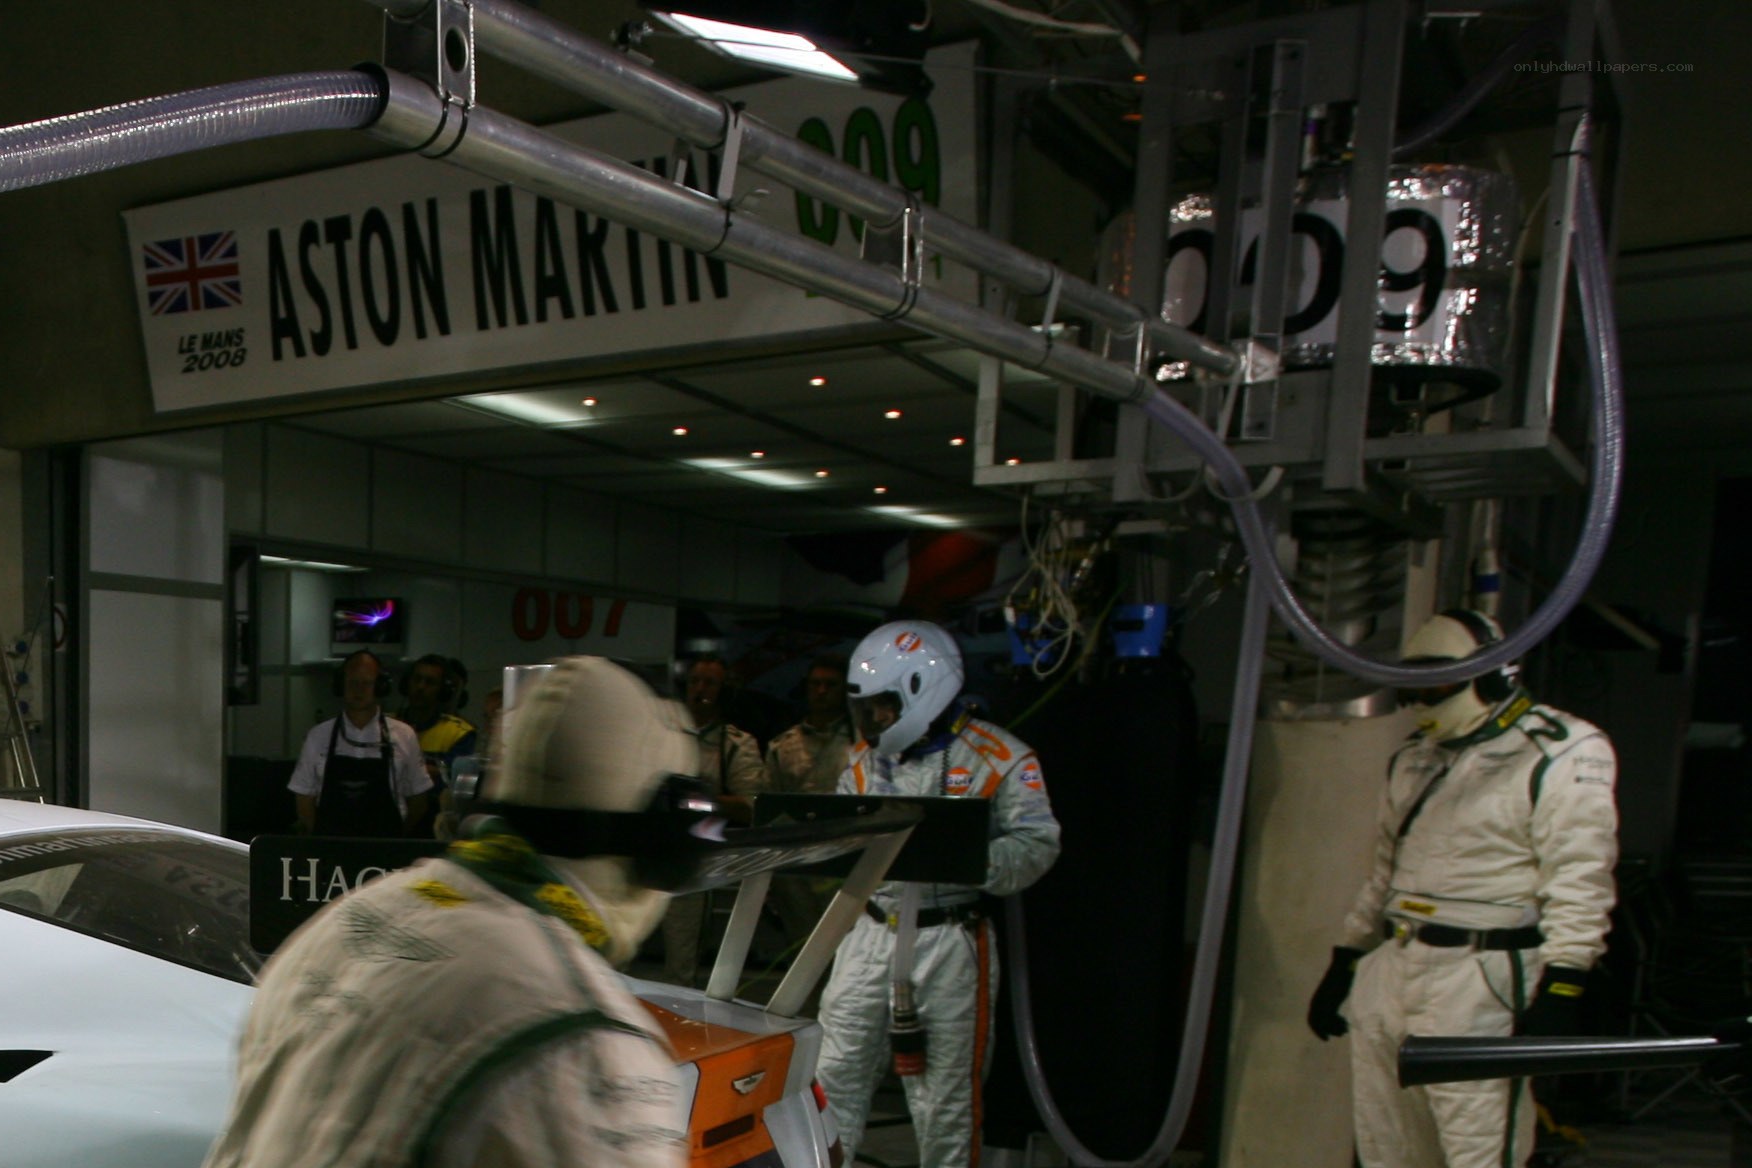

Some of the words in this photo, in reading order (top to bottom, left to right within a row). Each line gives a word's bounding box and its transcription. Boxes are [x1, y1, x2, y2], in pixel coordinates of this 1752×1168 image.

[268, 197, 451, 361] ASTON
[469, 152, 728, 331] MARTIN
[178, 334, 197, 354] LE
[201, 328, 245, 351] MANS
[181, 347, 247, 374] 2008
